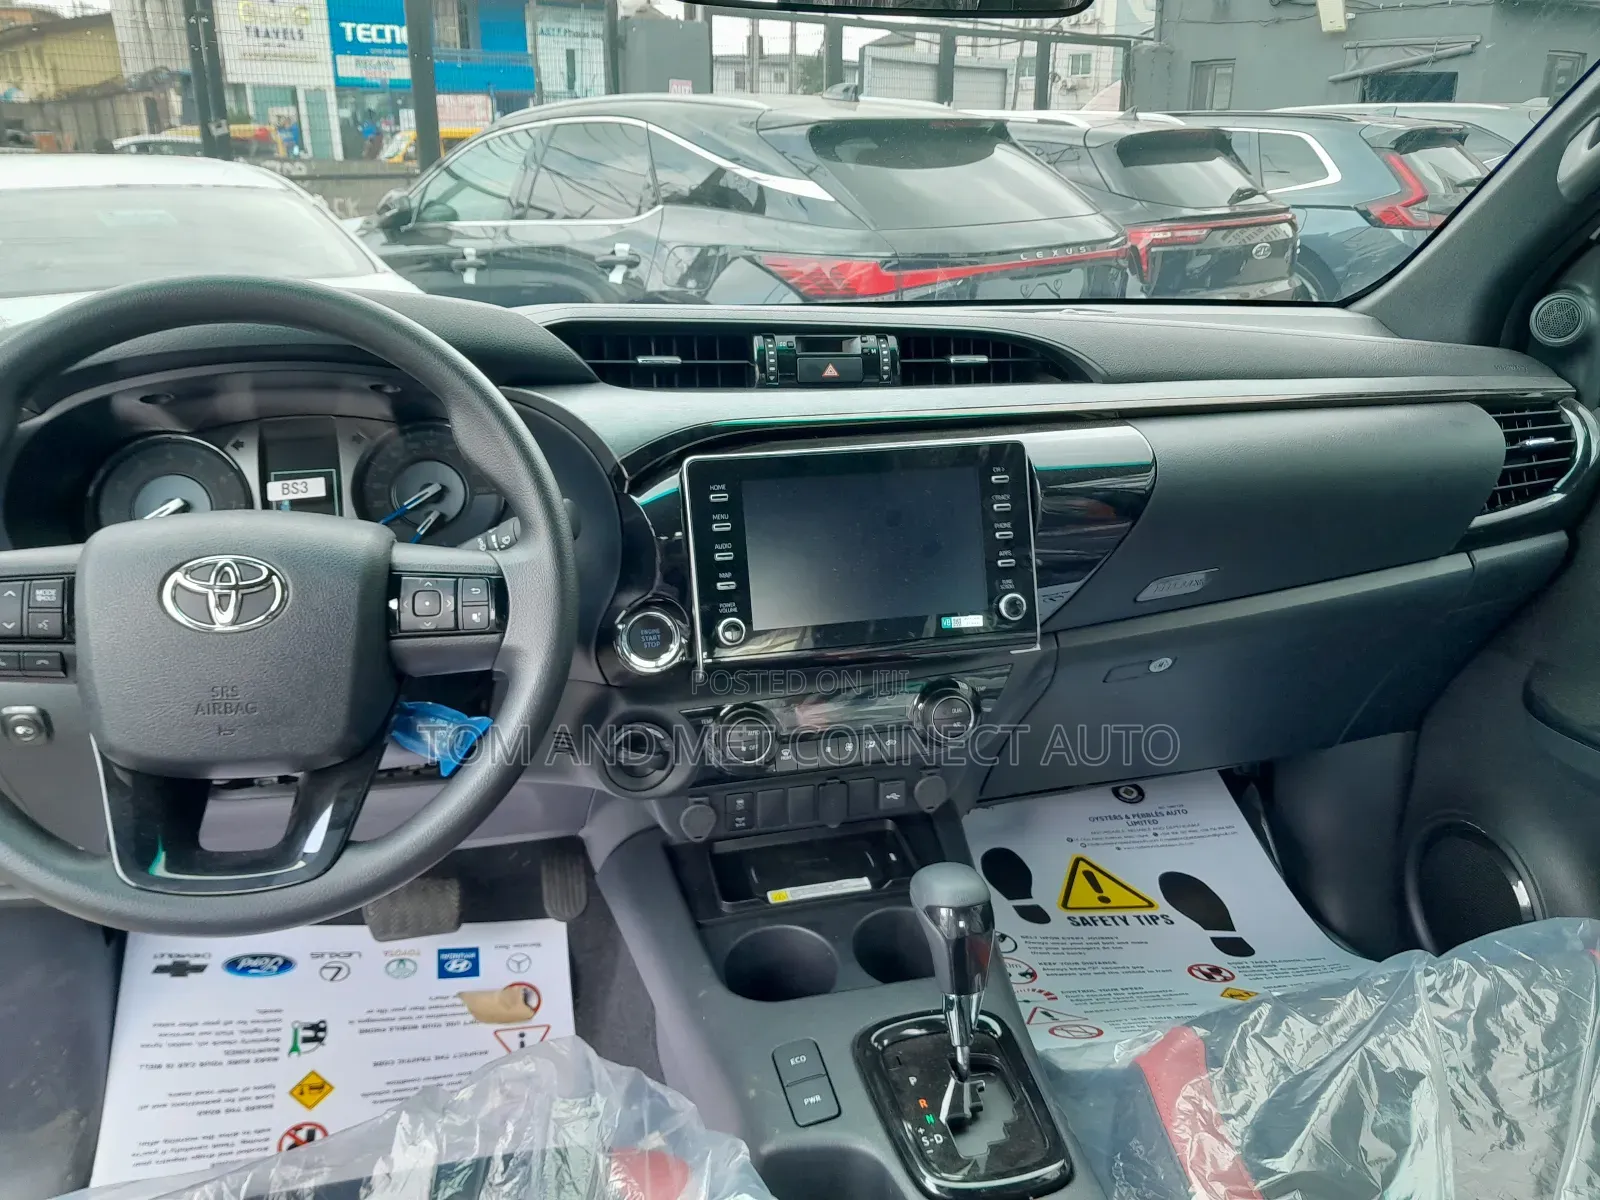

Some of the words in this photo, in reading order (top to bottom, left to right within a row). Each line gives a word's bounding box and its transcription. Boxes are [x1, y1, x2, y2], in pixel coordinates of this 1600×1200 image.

[1020, 246, 1087, 260] LEXUS
[282, 481, 308, 496] BS3
[212, 686, 240, 698] SRS
[194, 702, 259, 716] AIRBAG
[1088, 814, 1124, 822] OYSTERS
[1166, 808, 1188, 816] AUTO
[1126, 819, 1159, 827] LIMITED
[1067, 915, 1130, 927] SAFETY
[1133, 914, 1175, 926] TIPS
[310, 952, 362, 960] LEXUS
[236, 956, 283, 973] Ford
[790, 1055, 807, 1066] ECO
[908, 1076, 918, 1086] P
[804, 1095, 822, 1106] PWR
[918, 1098, 928, 1108] R
[924, 1114, 935, 1124] N
